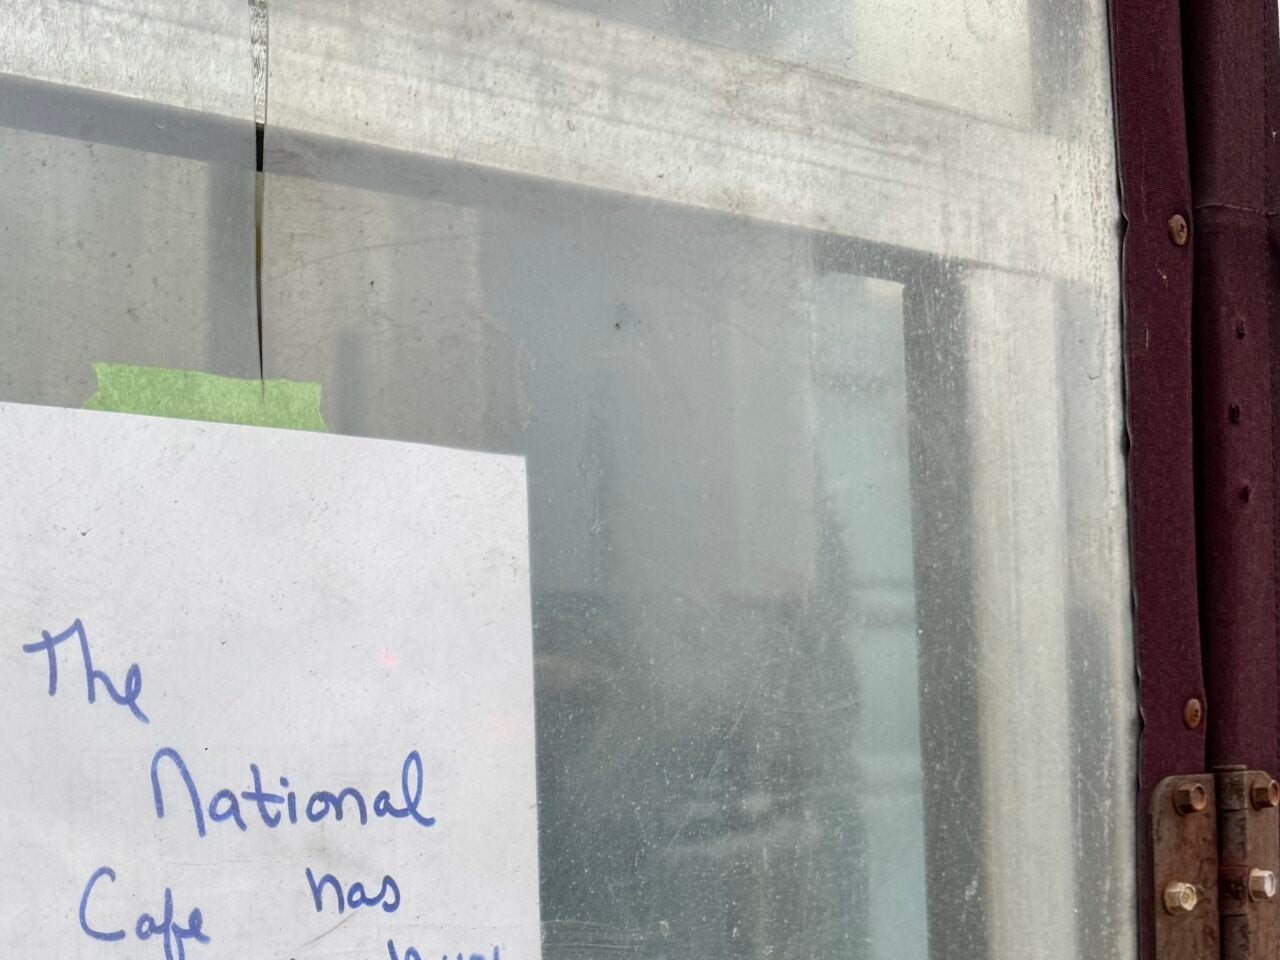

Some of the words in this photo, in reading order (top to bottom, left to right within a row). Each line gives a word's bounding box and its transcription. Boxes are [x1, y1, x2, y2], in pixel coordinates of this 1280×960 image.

[22, 618, 149, 723] The
[150, 747, 437, 838] National
[306, 868, 401, 913] has
